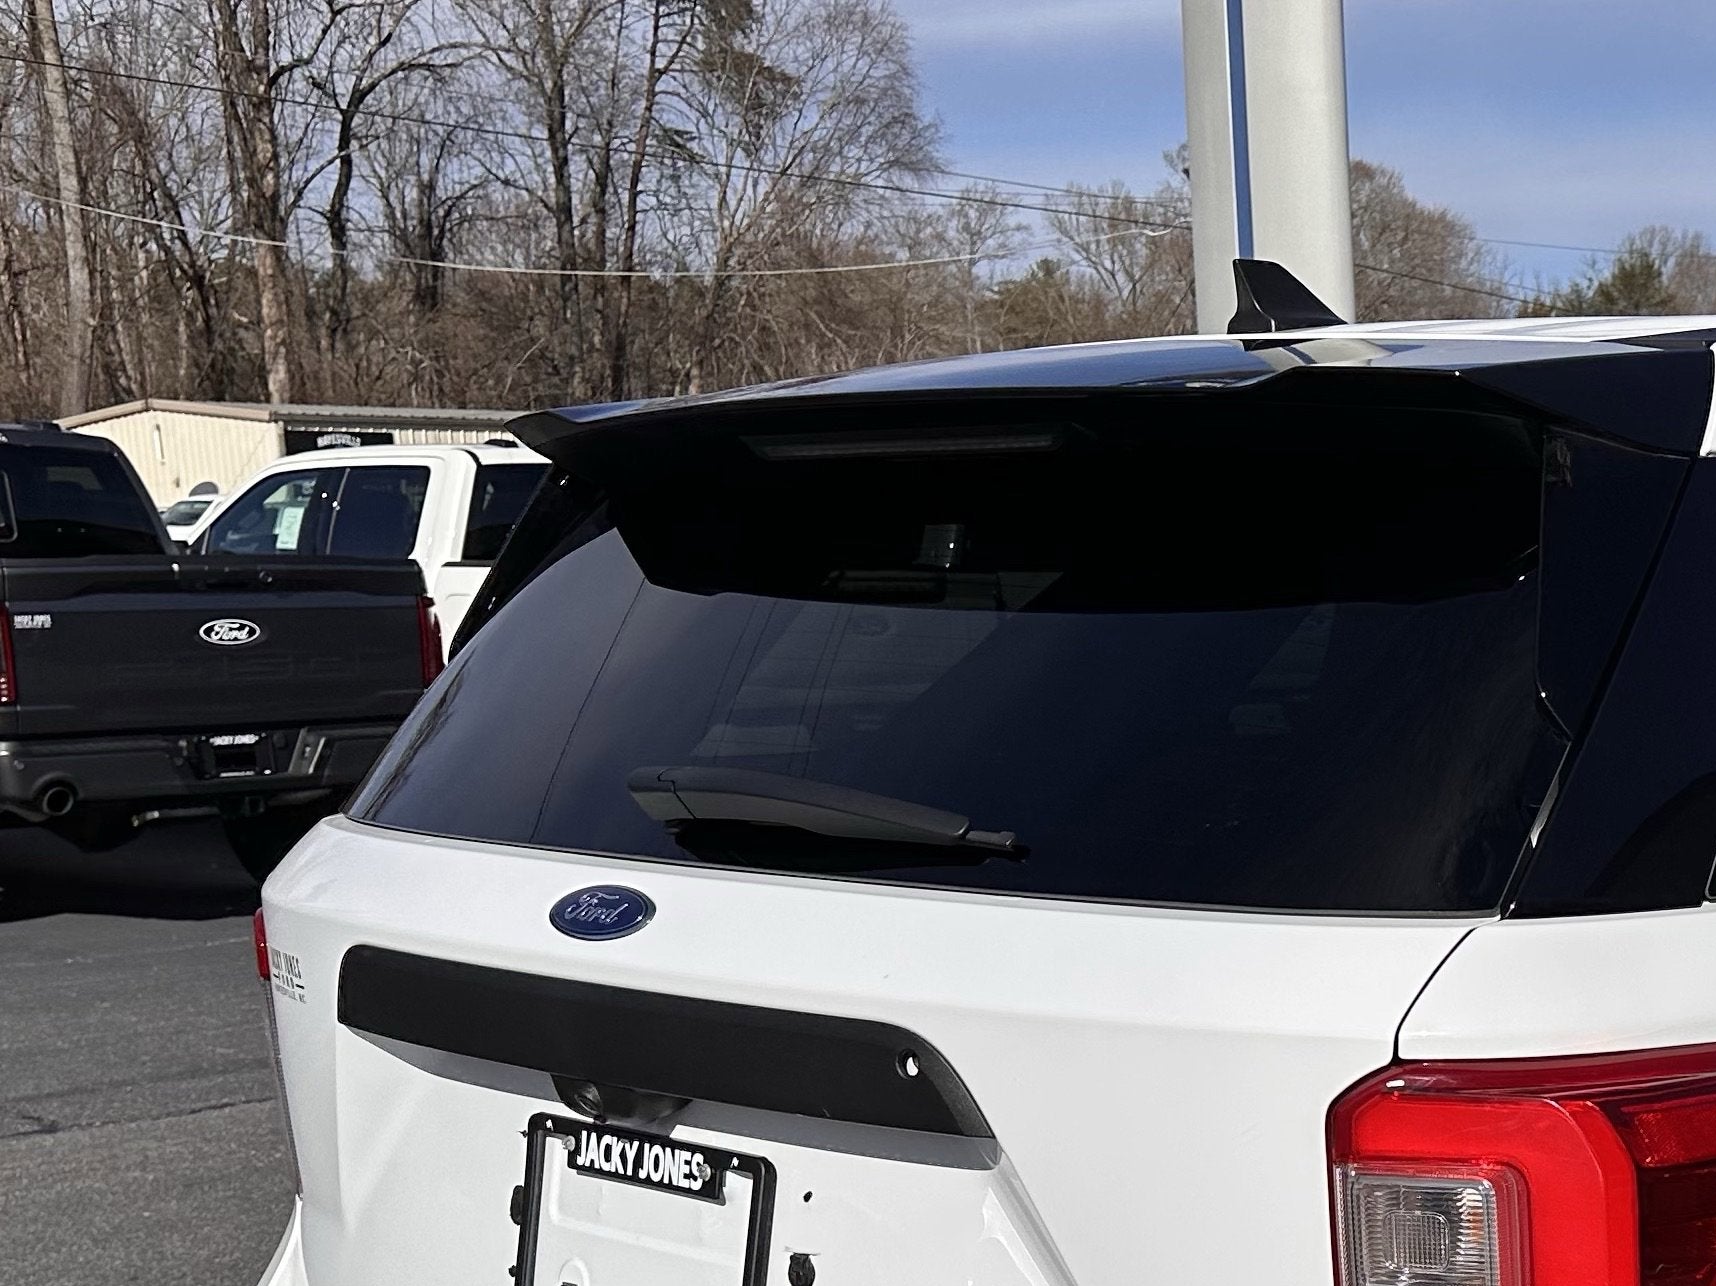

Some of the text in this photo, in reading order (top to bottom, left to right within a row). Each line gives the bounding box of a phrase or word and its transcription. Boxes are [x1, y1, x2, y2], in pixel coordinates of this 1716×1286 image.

[210, 622, 250, 641] Ford
[564, 890, 629, 926] Ford
[576, 1130, 705, 1192] JACKY JONES
